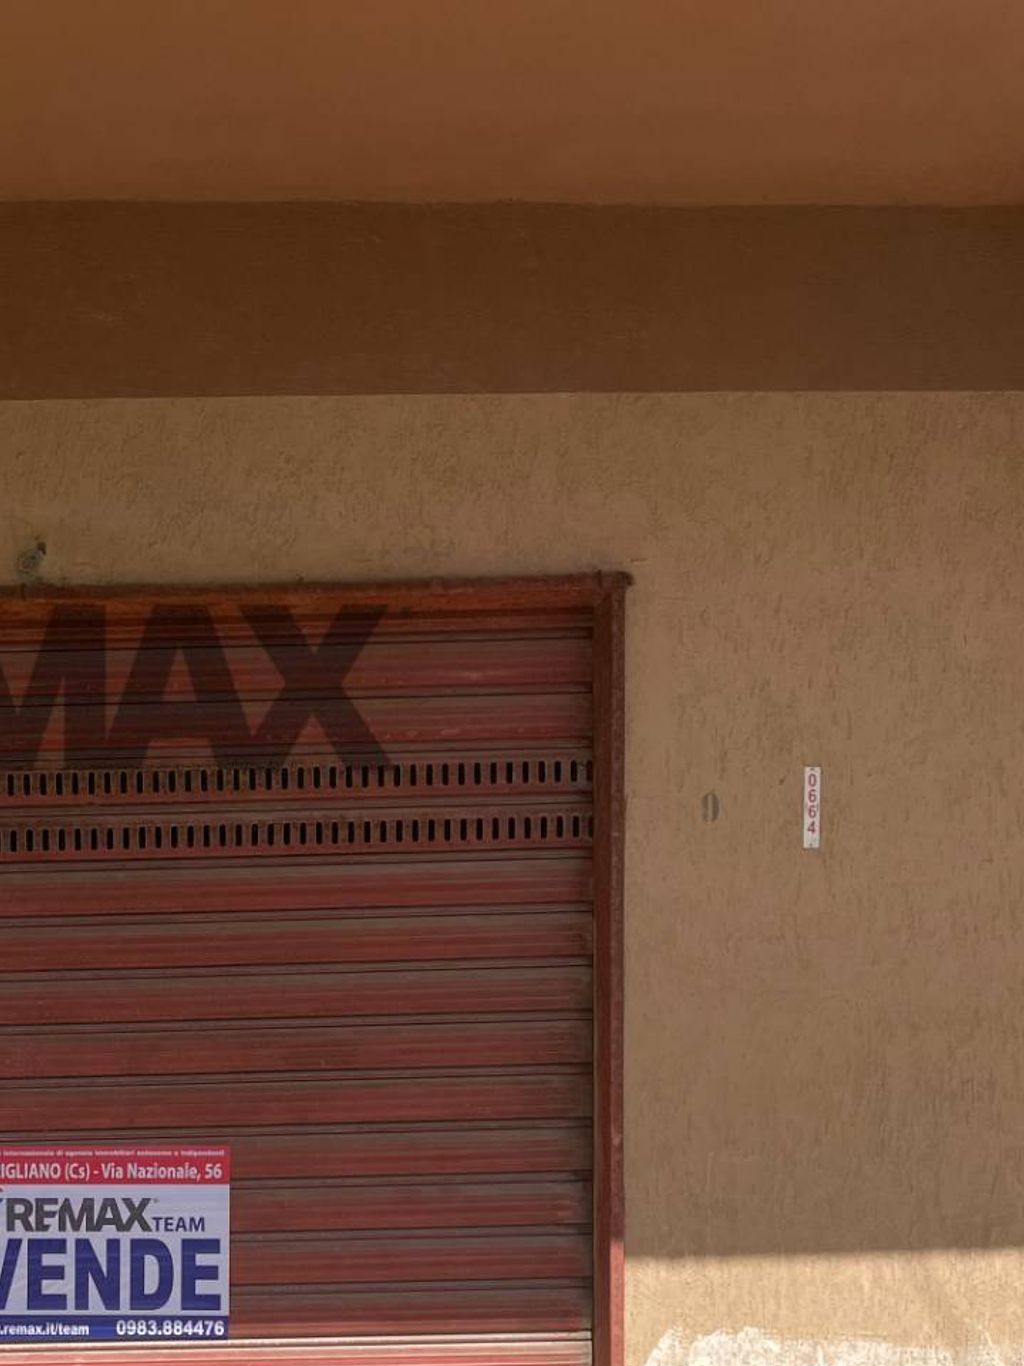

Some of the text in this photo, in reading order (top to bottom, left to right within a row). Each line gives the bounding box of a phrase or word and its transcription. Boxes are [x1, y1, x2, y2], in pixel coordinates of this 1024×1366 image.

[807, 773, 818, 835] 0664
[64, 1162, 90, 1182] (Cs)
[101, 1162, 124, 1180] Via
[127, 1162, 201, 1182] Nazionale,
[205, 1163, 223, 1180] 56
[153, 1216, 206, 1232] TEAM
[116, 1319, 225, 1337] 0983.884476
